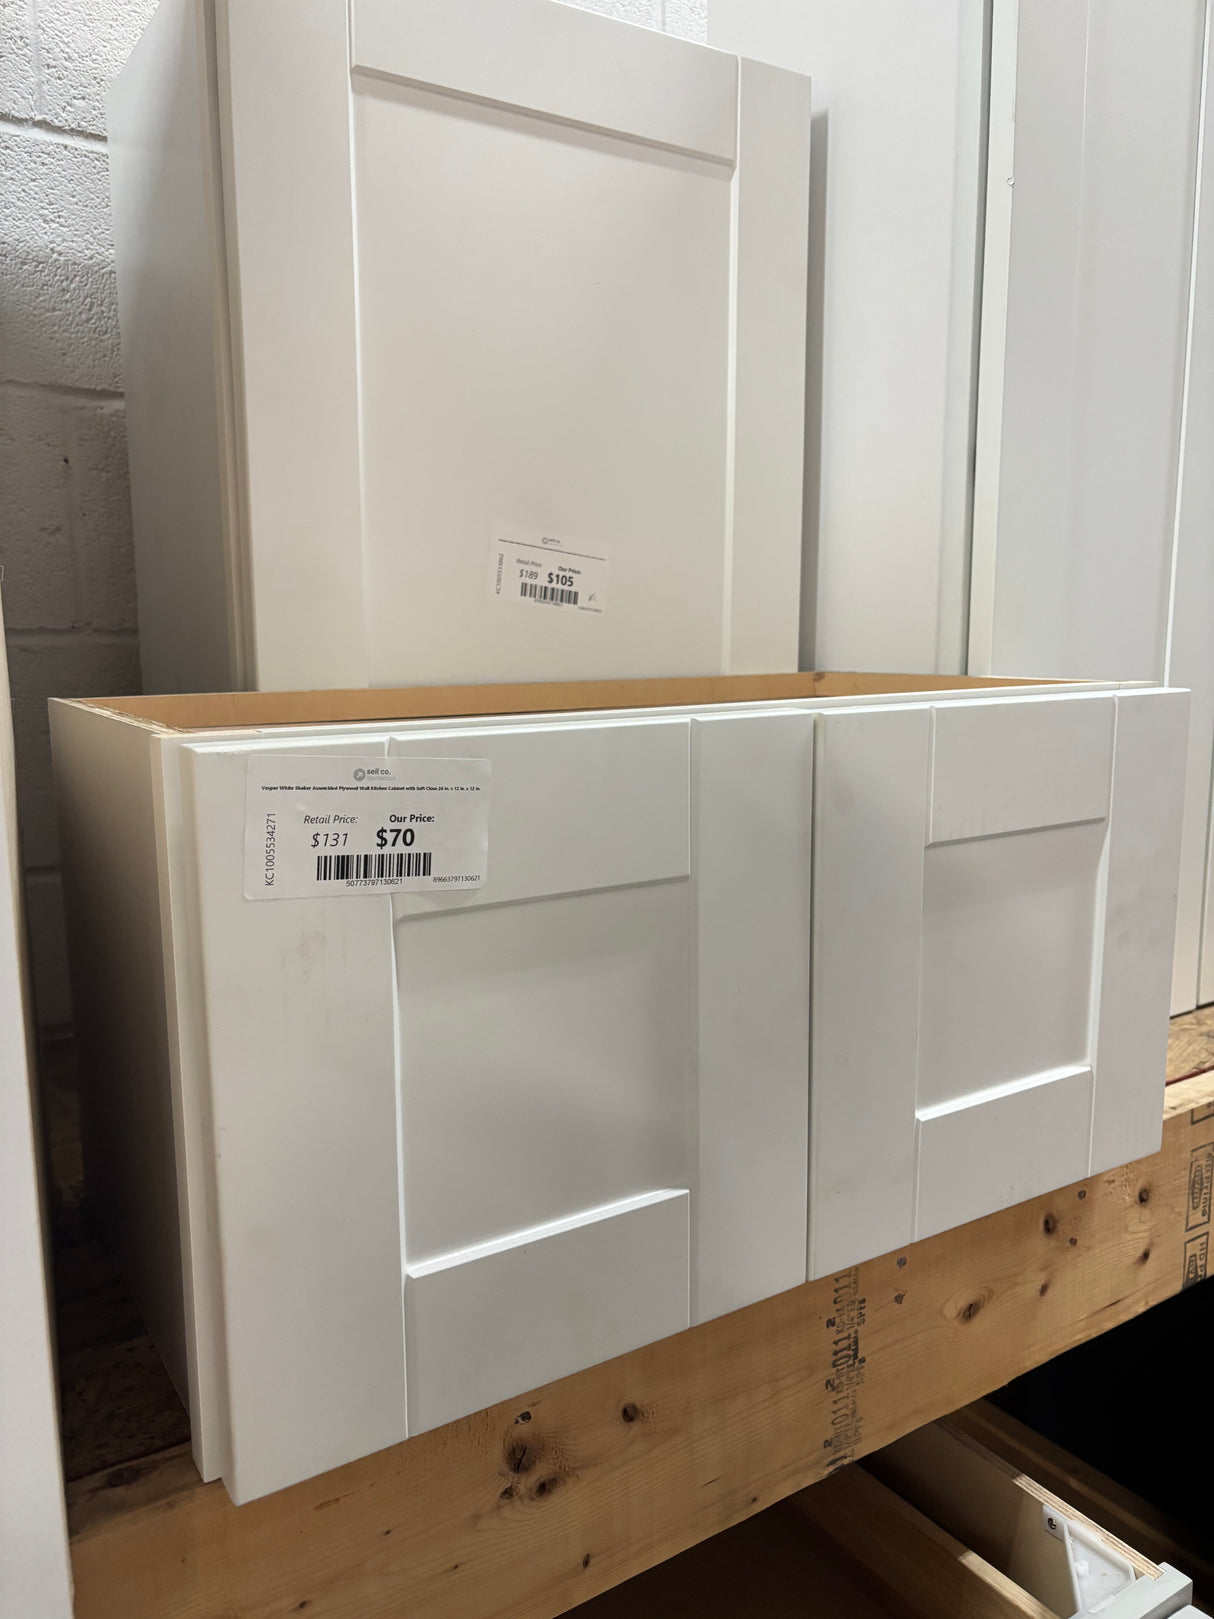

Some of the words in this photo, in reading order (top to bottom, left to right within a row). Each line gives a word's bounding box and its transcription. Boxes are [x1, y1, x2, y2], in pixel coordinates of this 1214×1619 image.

[516, 558, 530, 566] Retail
[519, 569, 539, 580] $189
[547, 572, 574, 587] $105
[303, 815, 330, 824] Retail
[333, 814, 358, 824] Price:
[389, 814, 407, 823] Our
[409, 814, 435, 823] Price:
[311, 832, 349, 848] $131
[376, 827, 415, 849] $70
[265, 813, 276, 886] KC1005534271
[832, 1333, 851, 1368] 011
